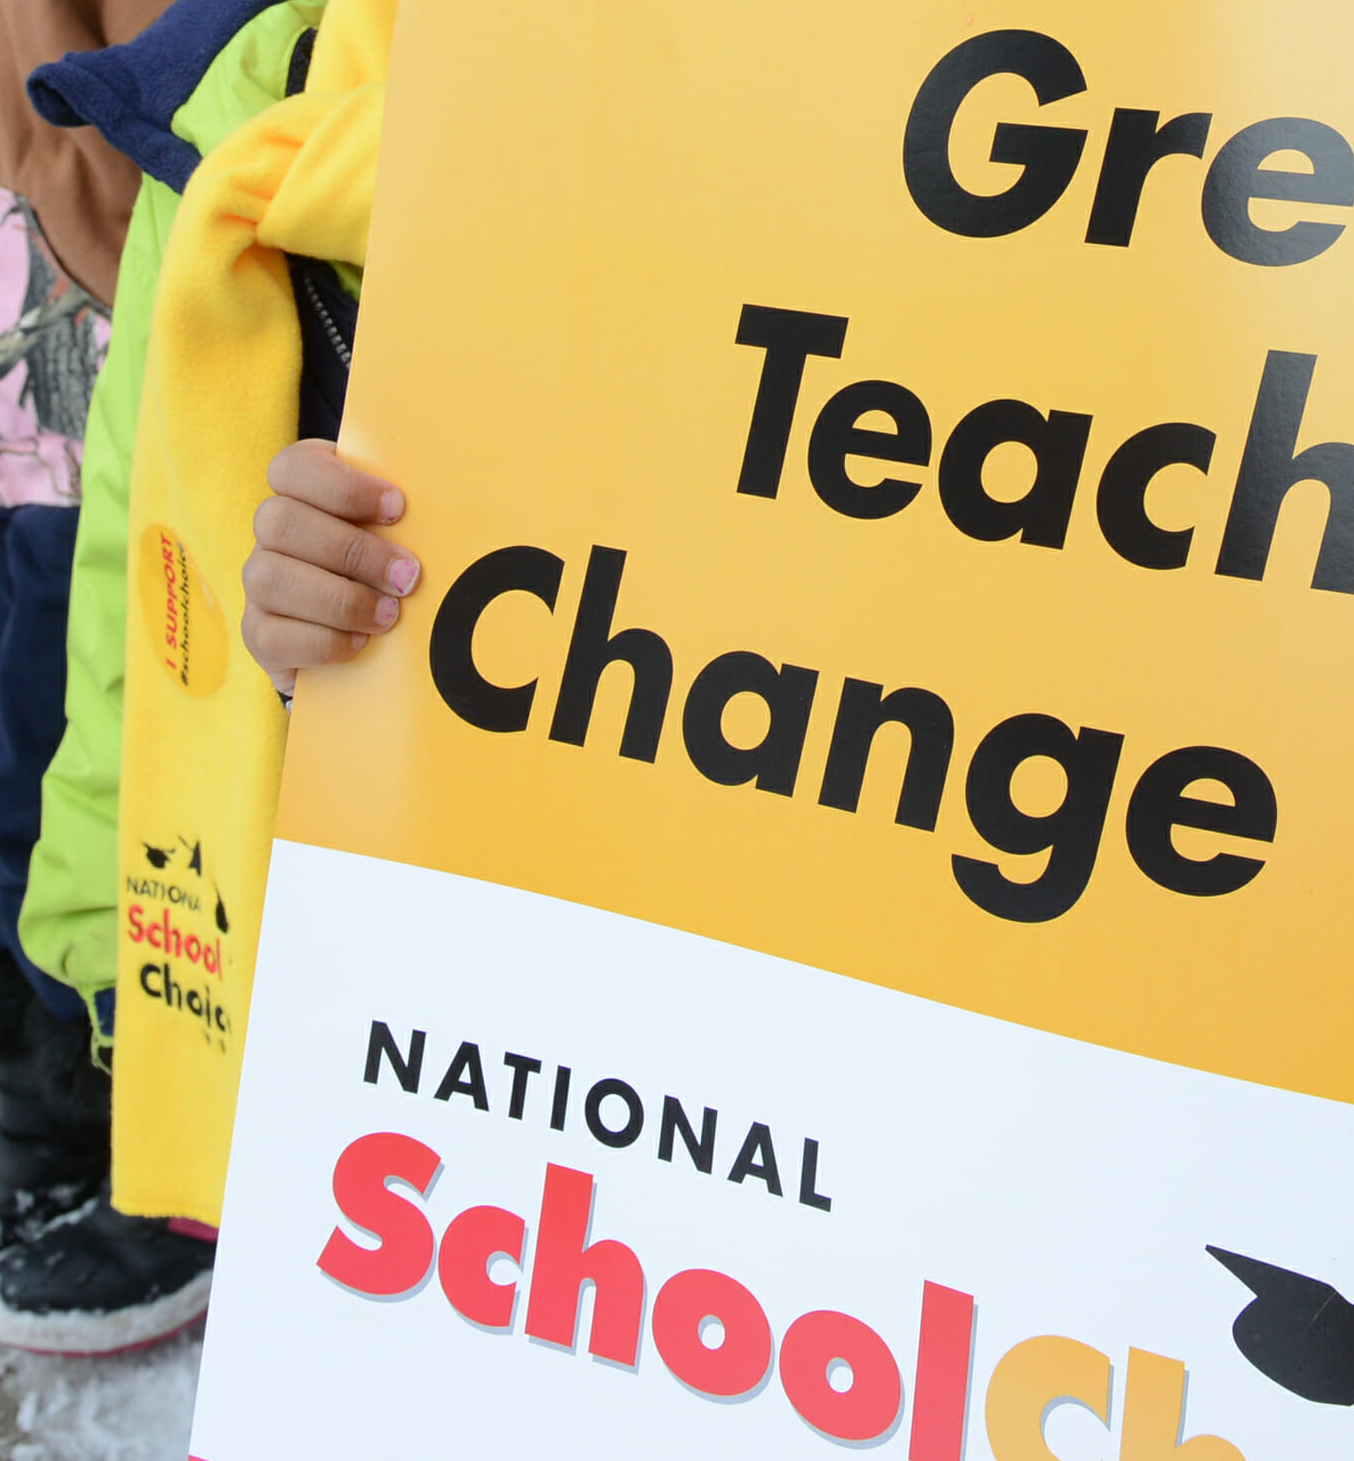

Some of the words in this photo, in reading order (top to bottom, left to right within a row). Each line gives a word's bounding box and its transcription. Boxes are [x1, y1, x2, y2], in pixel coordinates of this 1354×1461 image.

[160, 530, 179, 651] SUPPORT
[427, 544, 1278, 924] Change
[127, 903, 223, 982] School
[363, 1020, 833, 1213] NATIONAL
